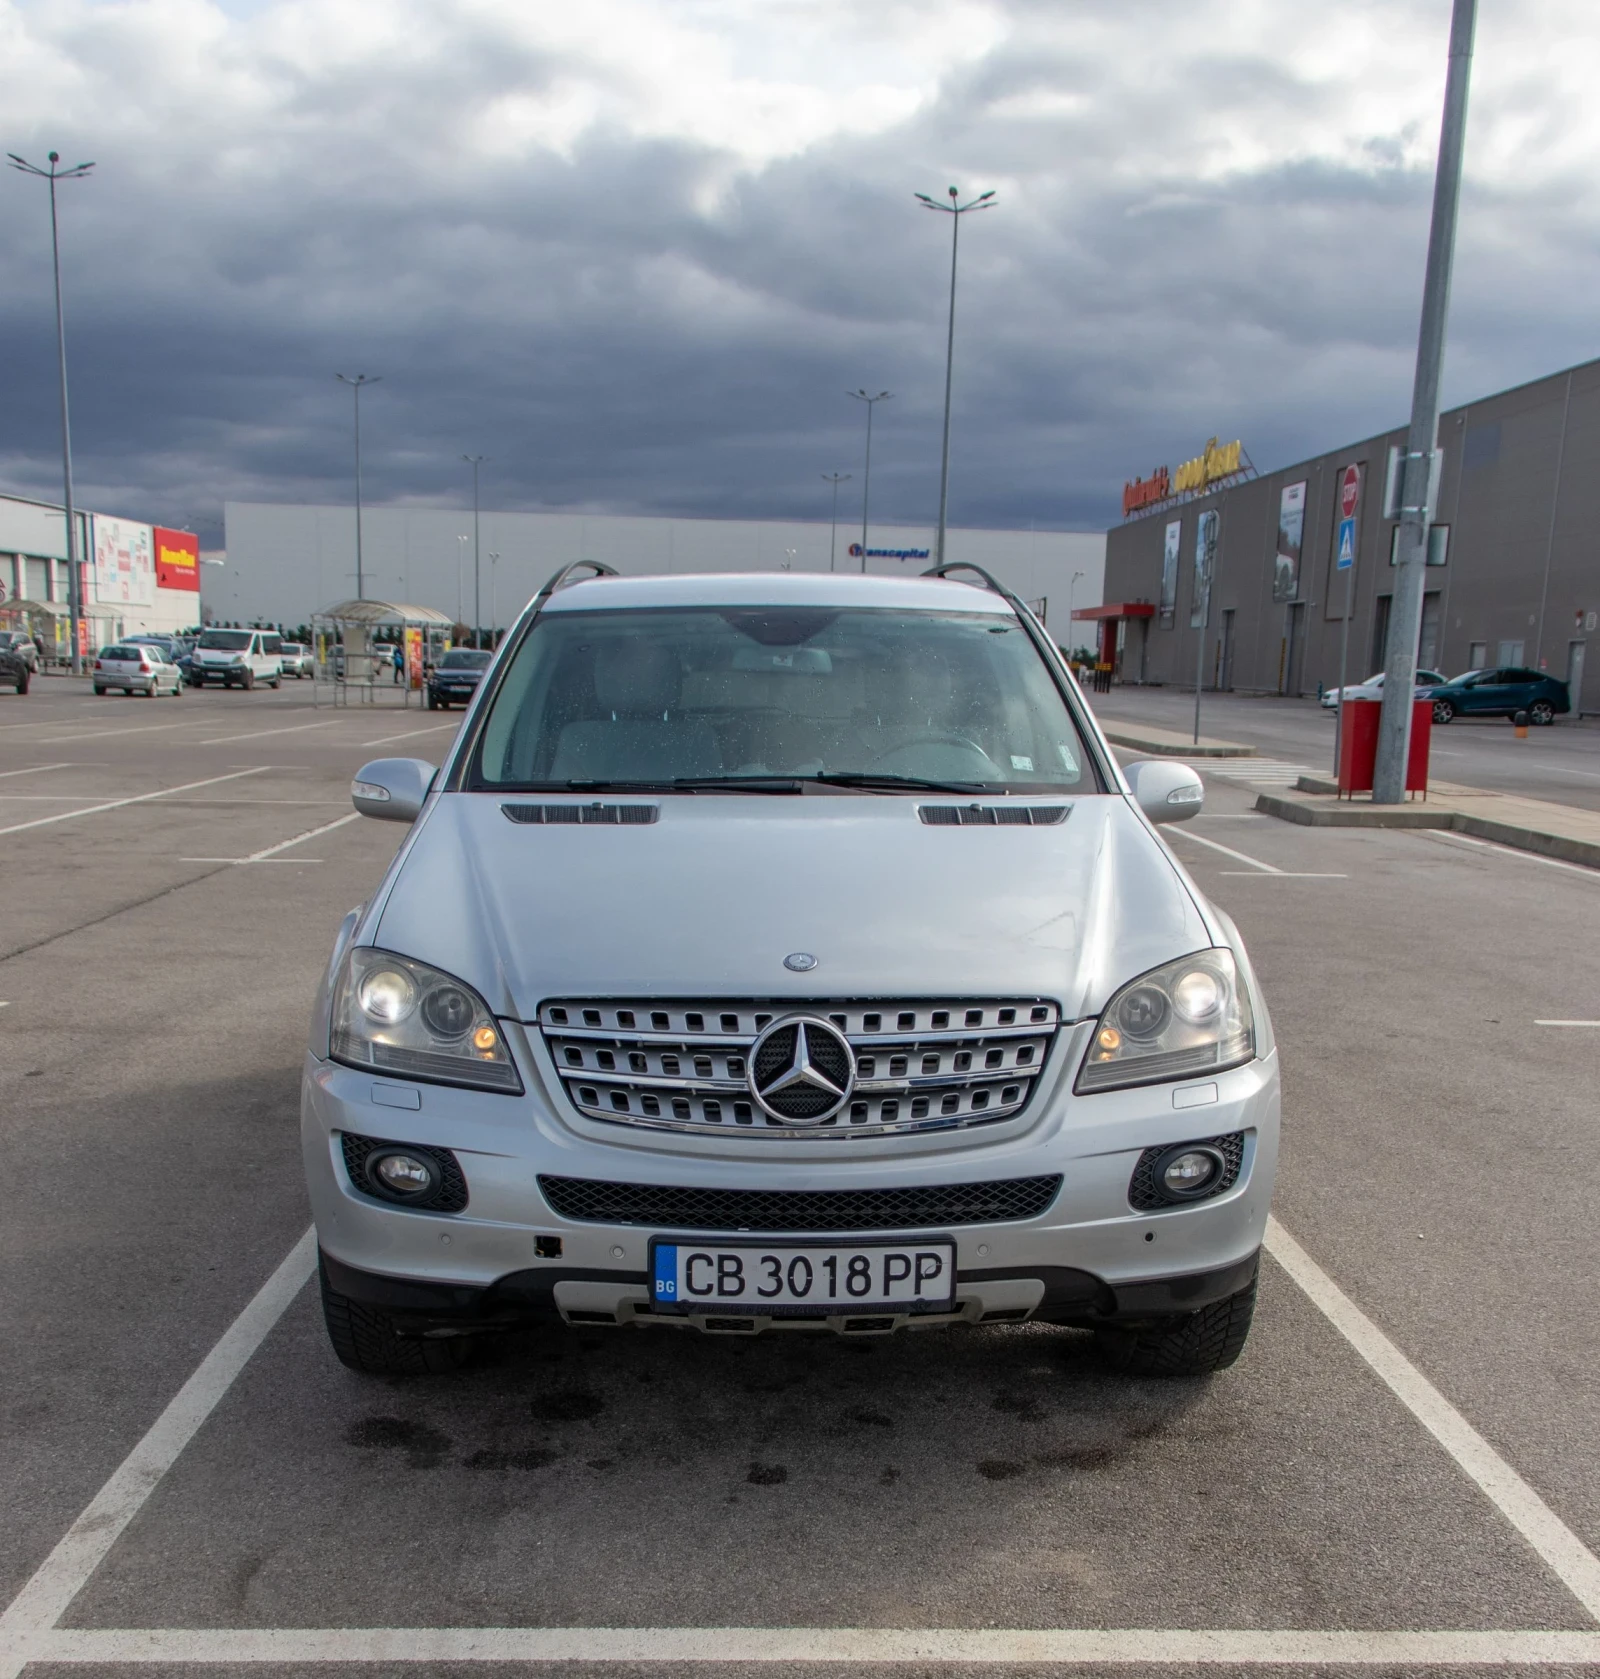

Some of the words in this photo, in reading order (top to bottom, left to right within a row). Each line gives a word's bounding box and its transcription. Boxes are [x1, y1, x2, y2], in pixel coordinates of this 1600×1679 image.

[1343, 482, 1357, 502] STOP
[685, 1252, 746, 1297] CB
[757, 1254, 872, 1298] 3018
[883, 1252, 943, 1297] PP
[656, 1279, 675, 1293] BG
